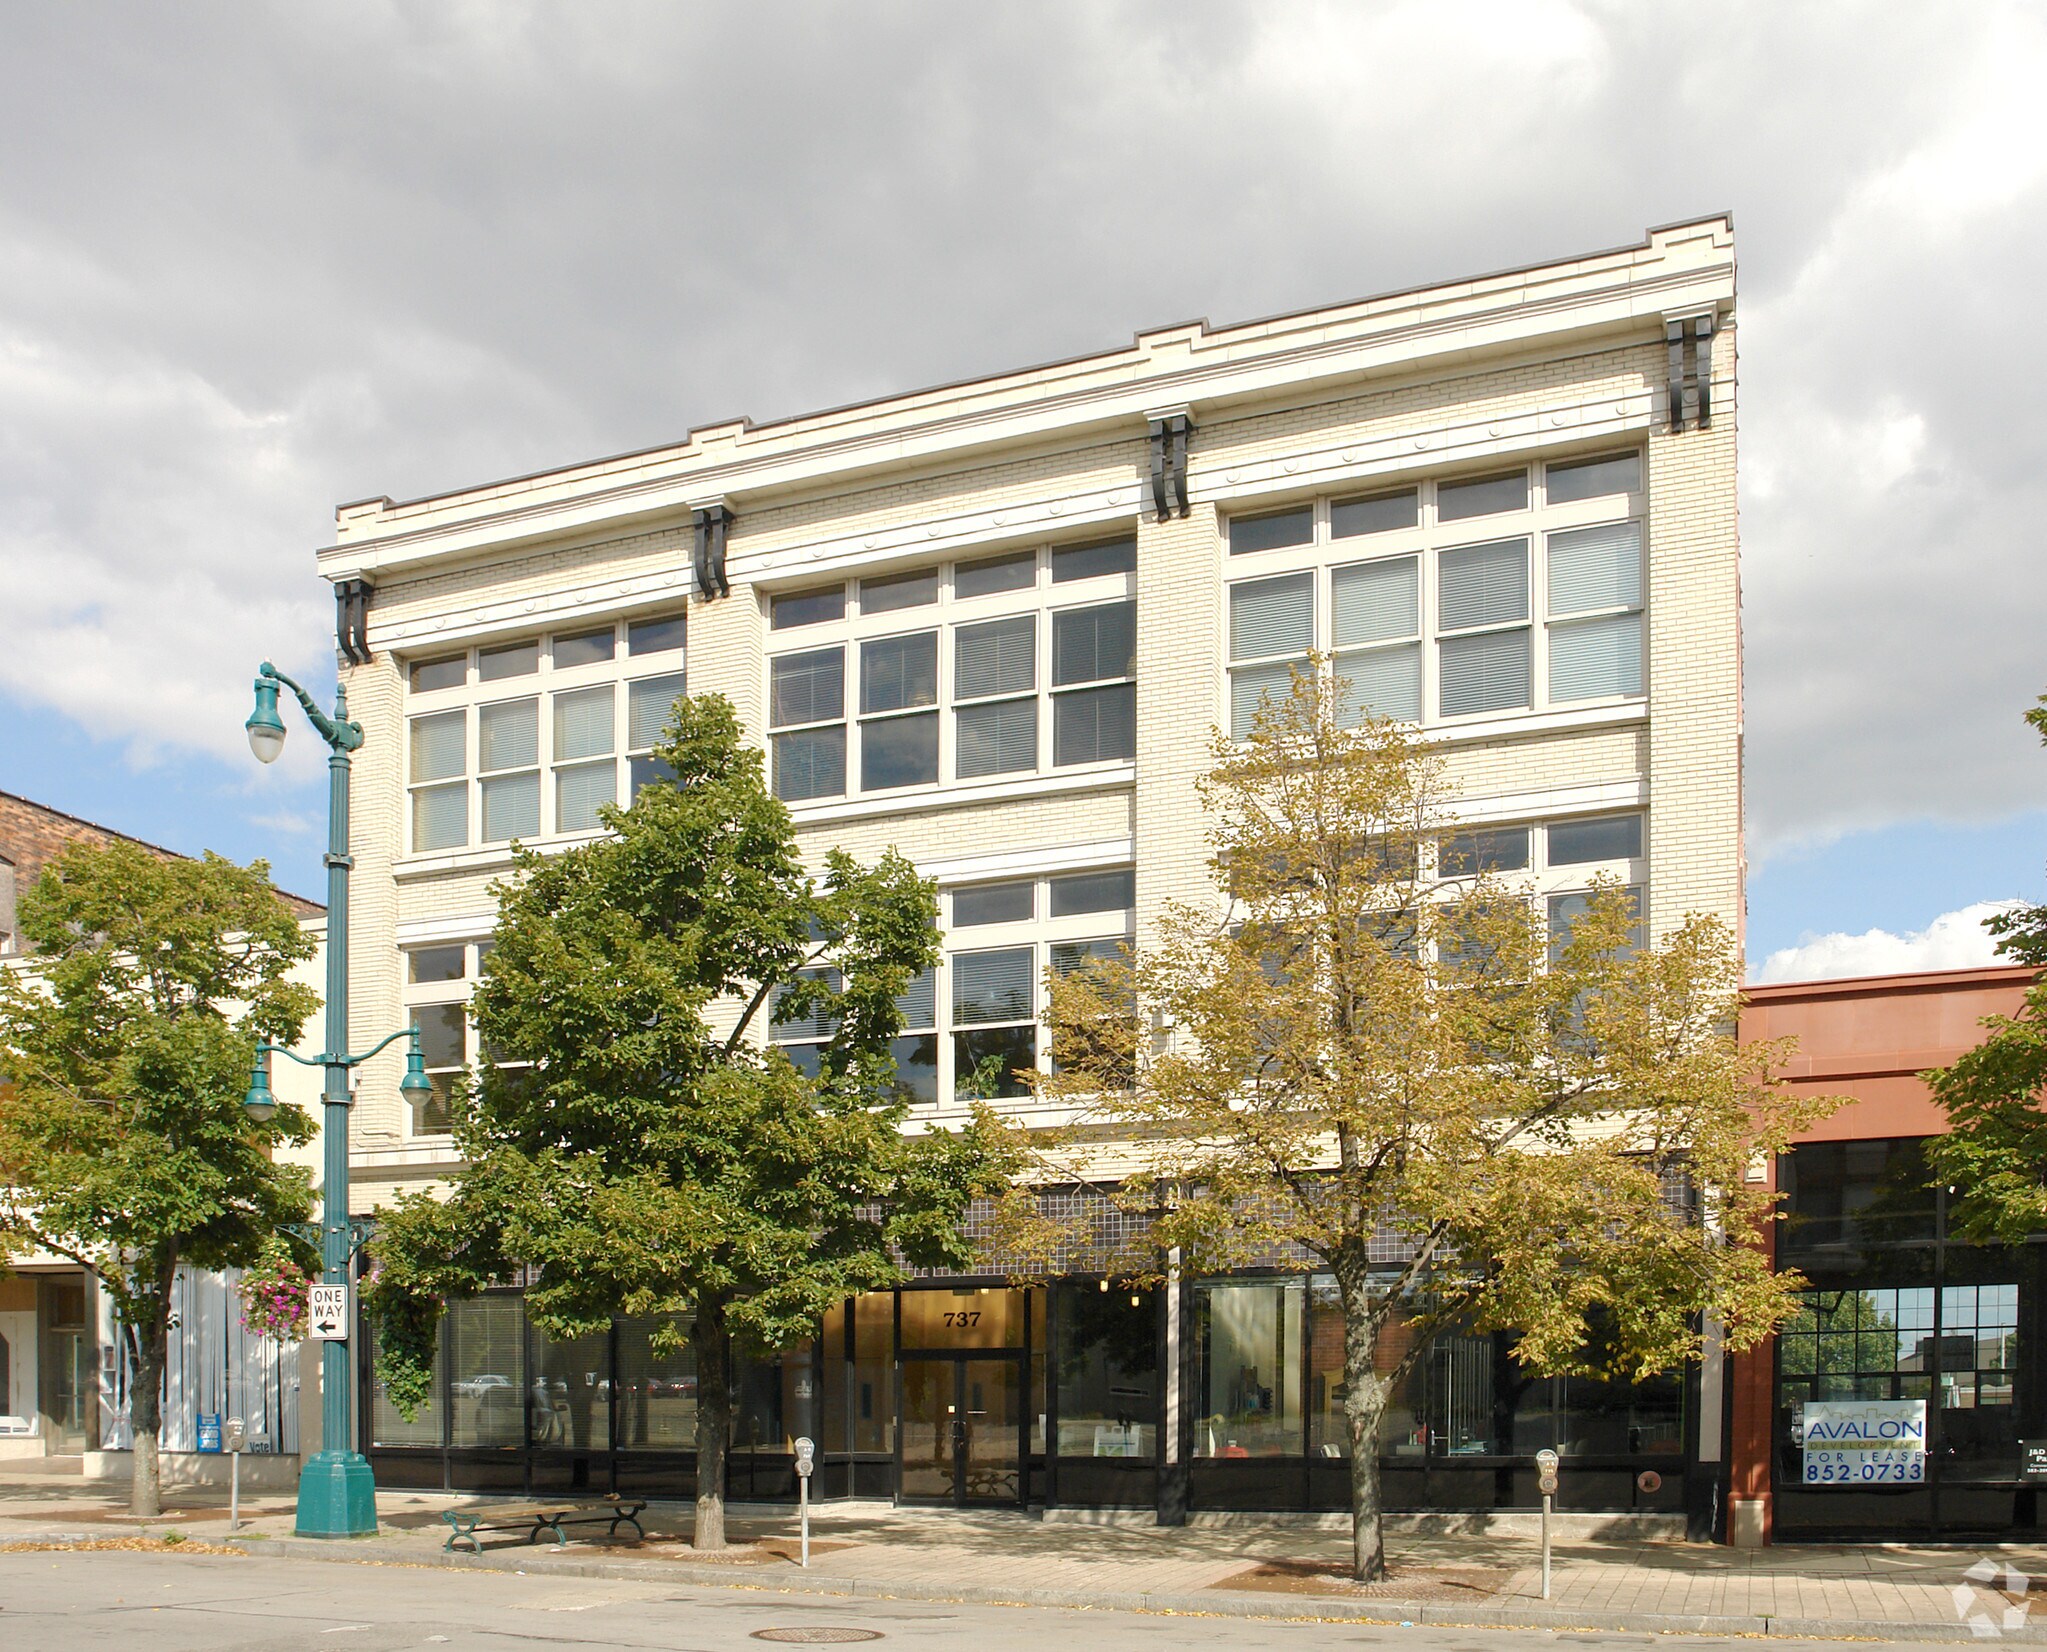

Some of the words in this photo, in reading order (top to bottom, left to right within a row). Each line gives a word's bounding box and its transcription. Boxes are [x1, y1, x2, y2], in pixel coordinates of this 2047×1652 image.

[314, 1290, 342, 1302] ONE
[314, 1305, 343, 1317] WAY
[943, 1311, 981, 1328] 737
[1807, 1421, 1923, 1439] AVALON
[249, 1442, 269, 1453] Vote
[1810, 1441, 1920, 1450] DEVELOPMENT
[1806, 1453, 1844, 1462] FOR
[1860, 1452, 1922, 1462] LEASE
[1806, 1464, 1921, 1481] 852-0733
